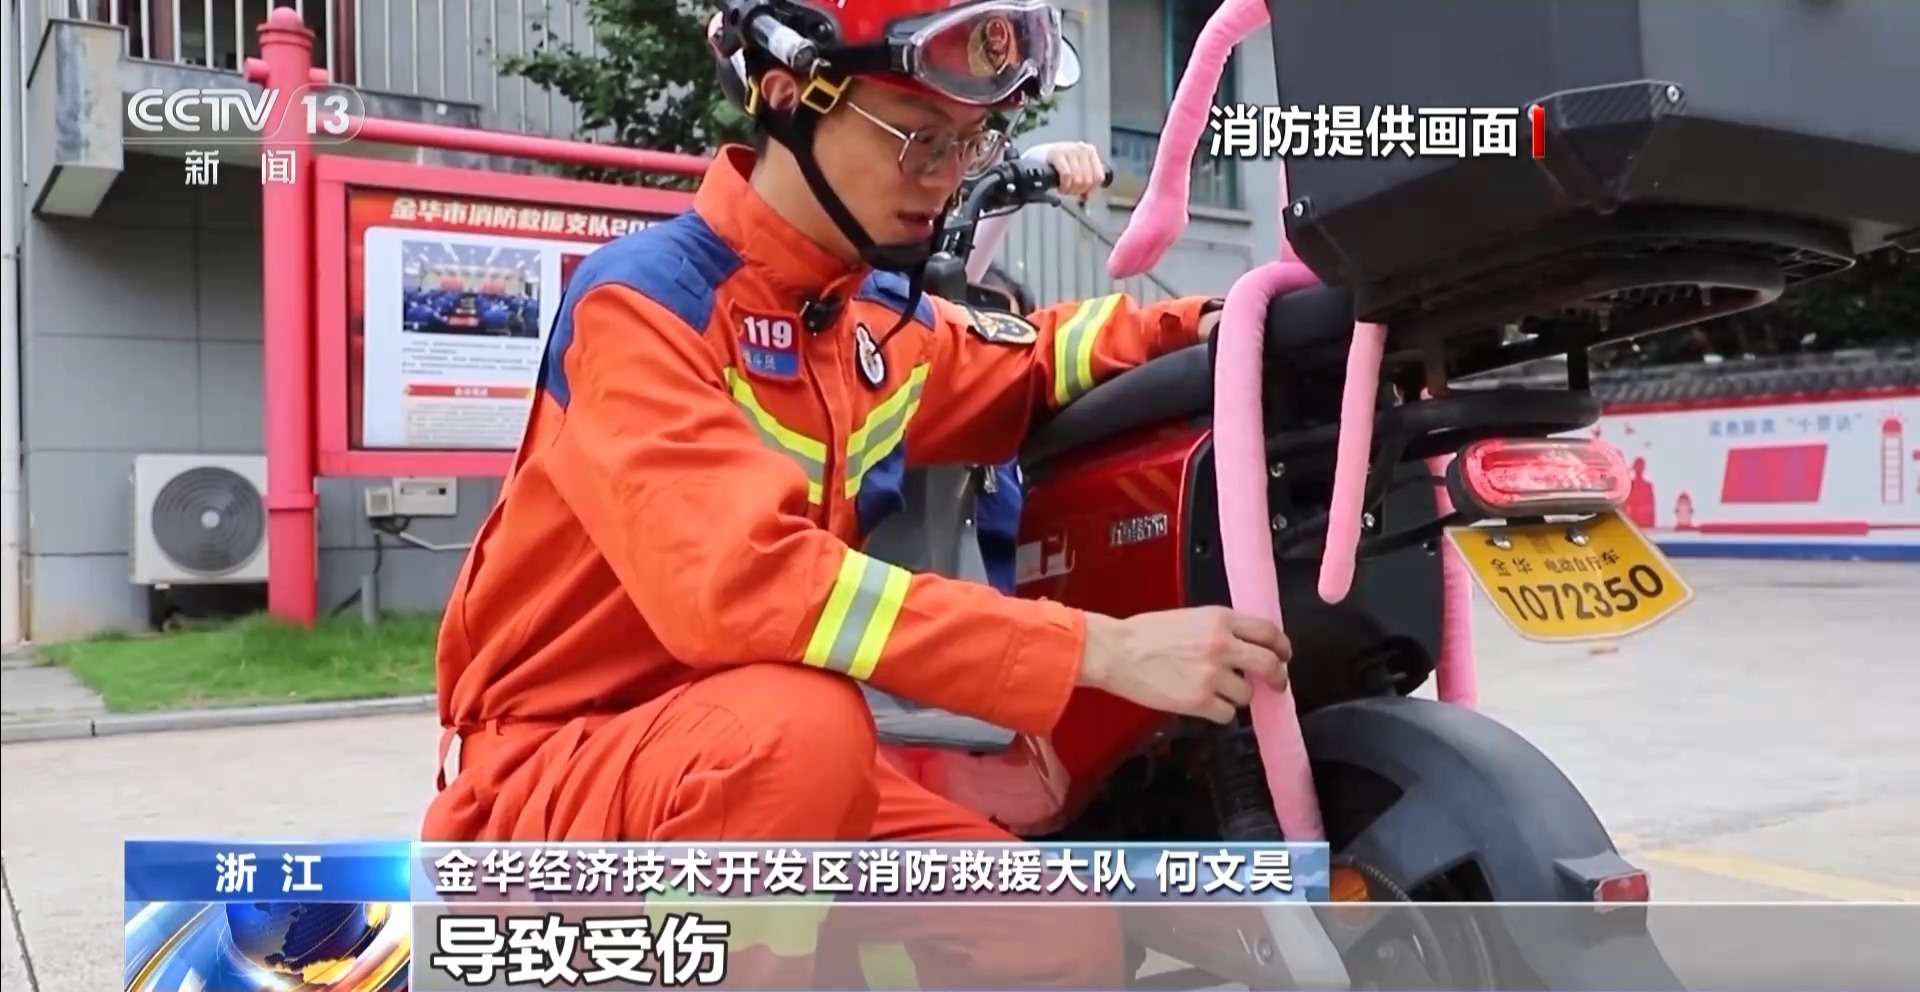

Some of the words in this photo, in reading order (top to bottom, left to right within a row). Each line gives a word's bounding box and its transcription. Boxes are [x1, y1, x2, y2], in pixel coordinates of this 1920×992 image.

[744, 316, 793, 349] 119
[1491, 557, 1533, 577] 金华
[1544, 549, 1621, 575] 电动自行车
[1498, 564, 1664, 622] 1072350
